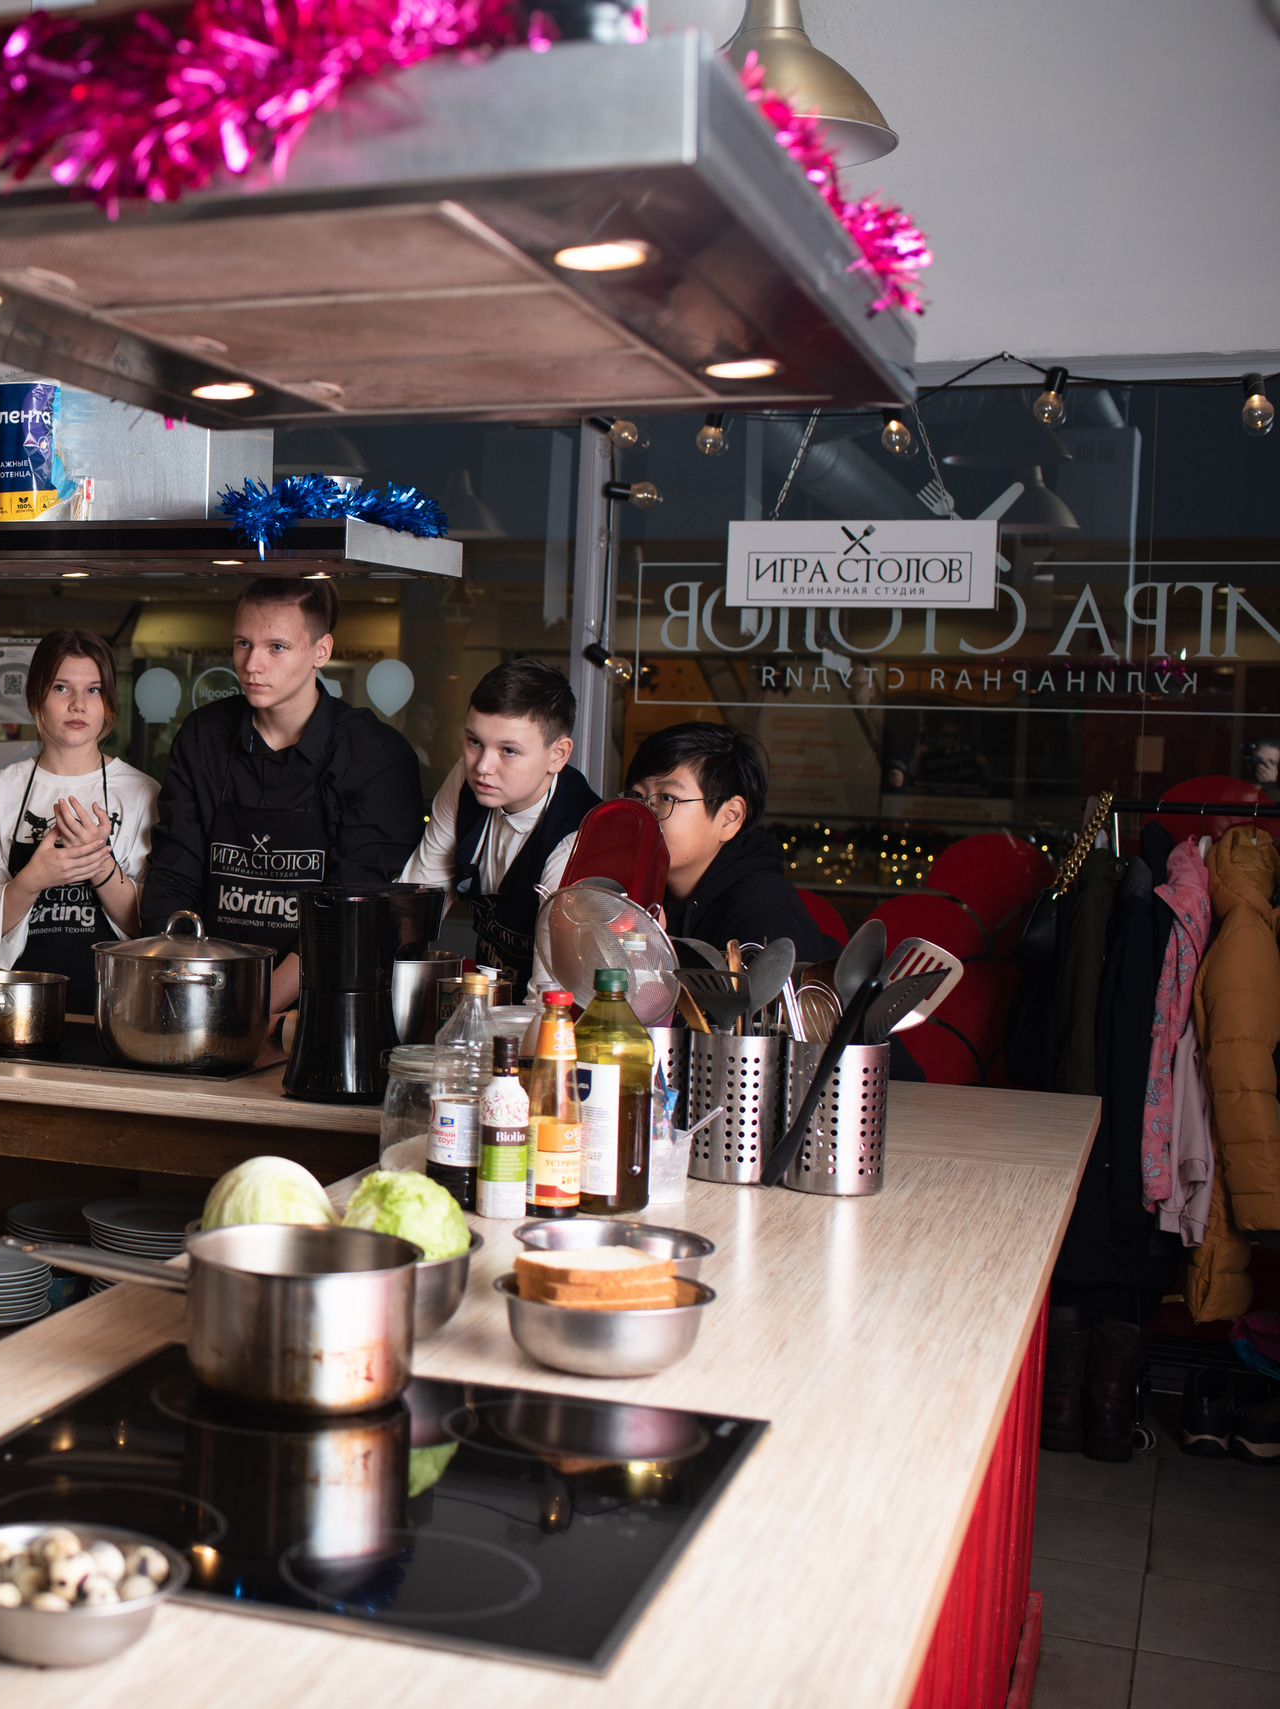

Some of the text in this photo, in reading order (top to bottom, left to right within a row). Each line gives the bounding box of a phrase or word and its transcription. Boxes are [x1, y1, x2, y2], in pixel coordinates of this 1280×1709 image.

[754, 557, 963, 583] ИГРА СТОЛОВ
[782, 586, 926, 597] КУЛИНАРНАЯ СТУДИЯ
[213, 846, 320, 870] ИГРА СТОЛОВ
[218, 884, 298, 922] körting
[29, 903, 96, 927] örting
[64, 926, 96, 934] техника
[430, 1126, 456, 1138] Соевый
[495, 1131, 526, 1142] Biolio
[437, 1136, 456, 1146] соус
